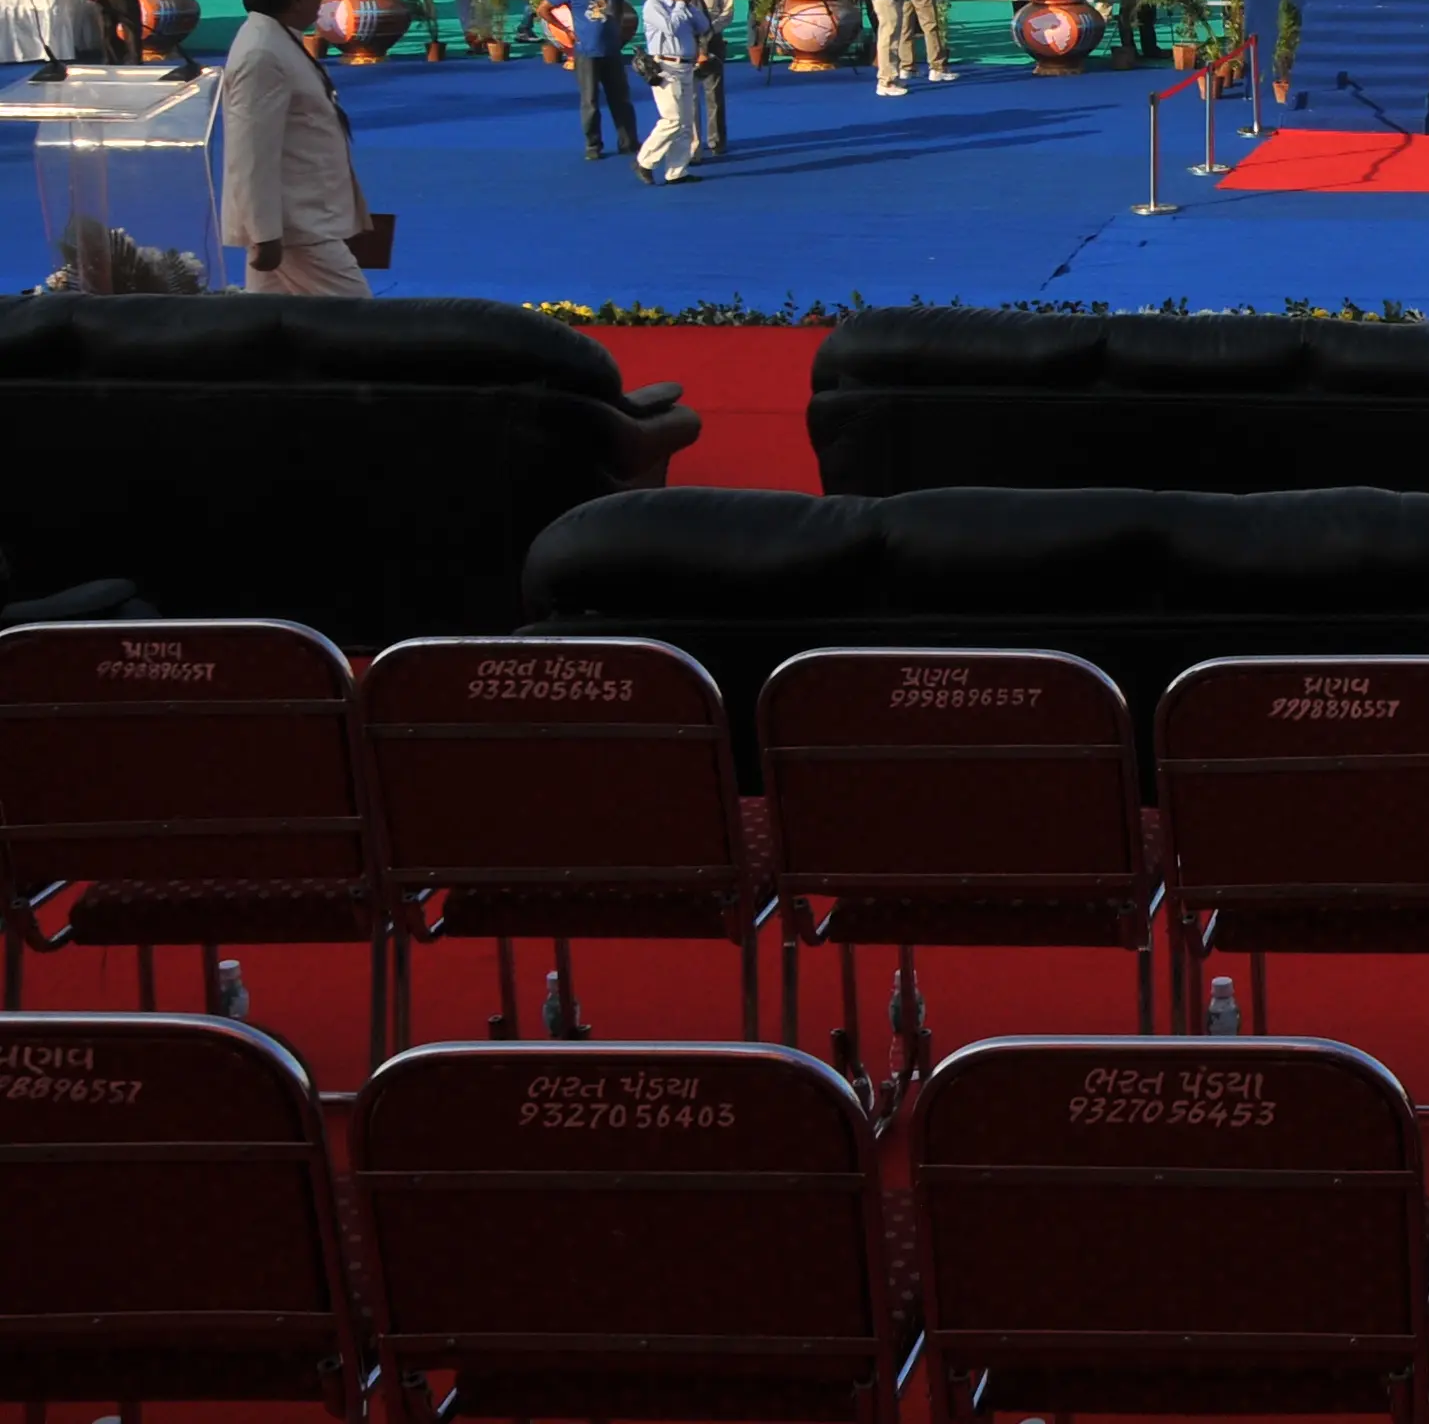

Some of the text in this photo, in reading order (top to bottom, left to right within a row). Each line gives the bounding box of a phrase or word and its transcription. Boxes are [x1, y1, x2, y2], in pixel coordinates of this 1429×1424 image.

[96, 661, 217, 682] 9998896557
[478, 658, 539, 678] ભરત
[467, 679, 634, 702] 9327056453
[889, 688, 1043, 709] 9998896557
[1266, 698, 1401, 721] 9998896557
[528, 1075, 607, 1099] ભરત
[1085, 1067, 1165, 1096] ભરત
[517, 1101, 736, 1129] 9327056403
[1067, 1096, 1277, 1129] 9327056453
